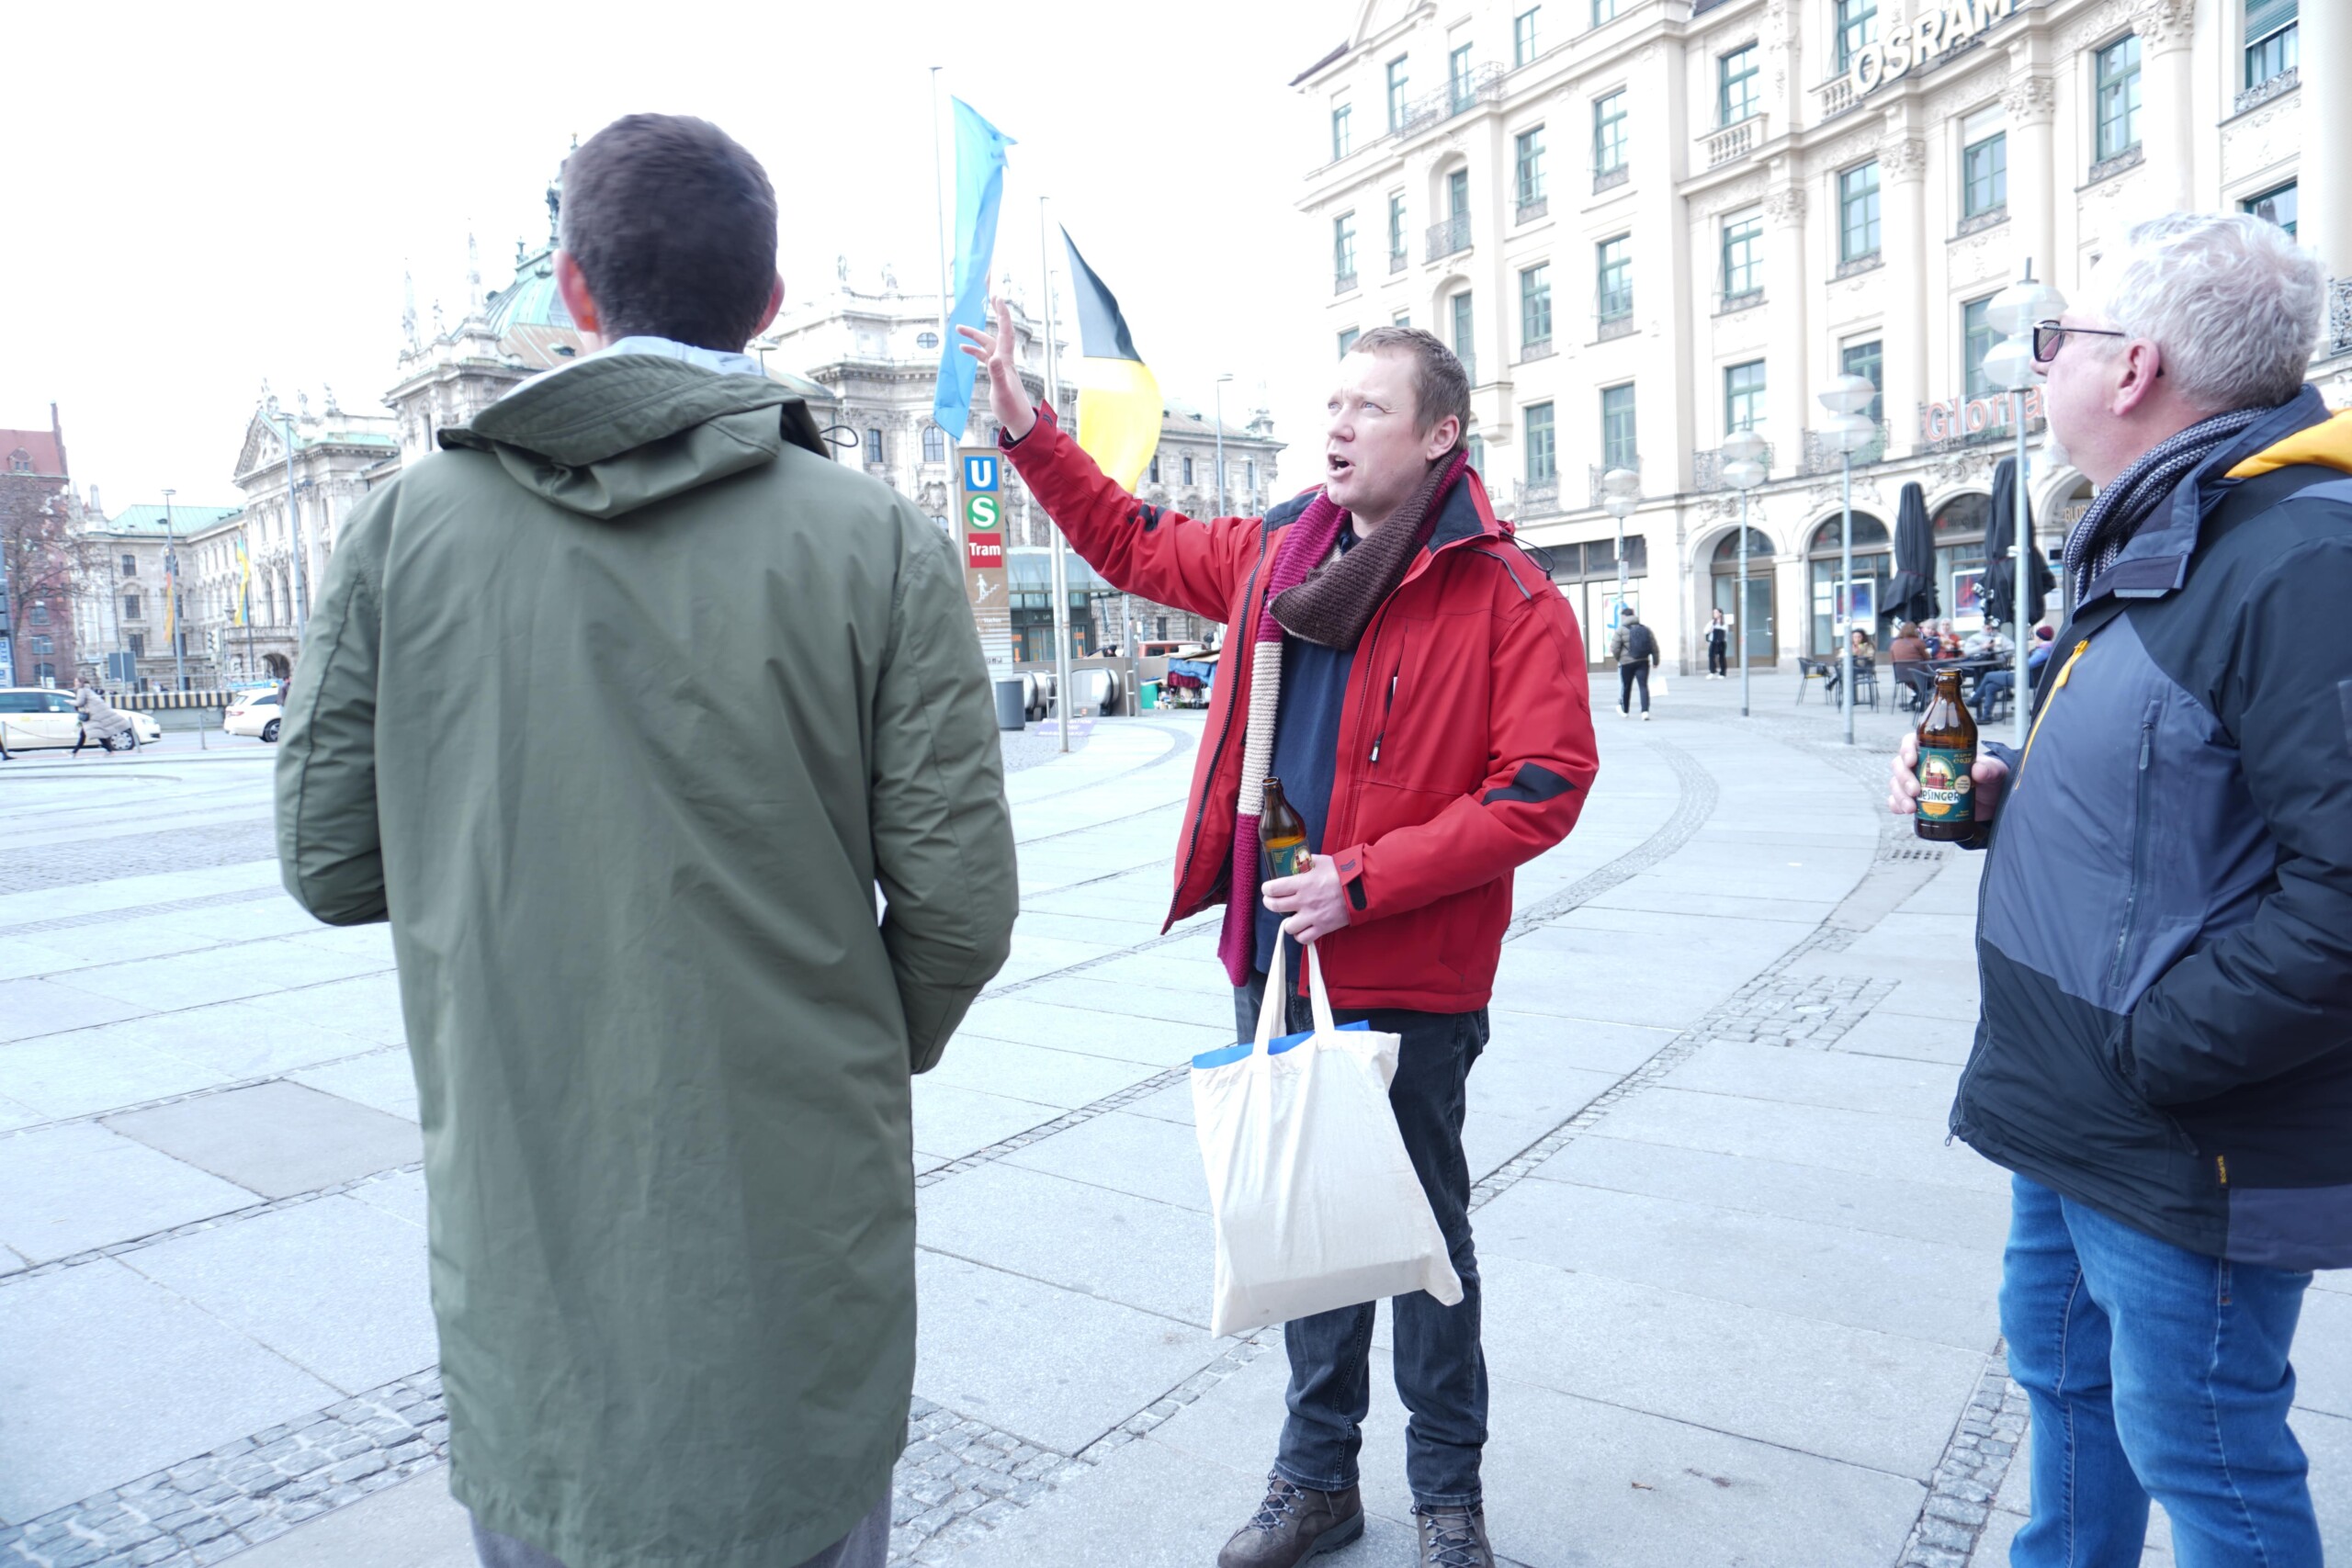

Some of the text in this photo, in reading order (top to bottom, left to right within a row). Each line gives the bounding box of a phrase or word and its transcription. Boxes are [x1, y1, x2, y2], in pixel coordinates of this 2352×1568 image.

[1850, 0, 2015, 96] OSRAM
[1926, 384, 2044, 442] Gloria
[970, 460, 991, 488] U
[971, 497, 996, 527] S
[968, 542, 1001, 557] Tram
